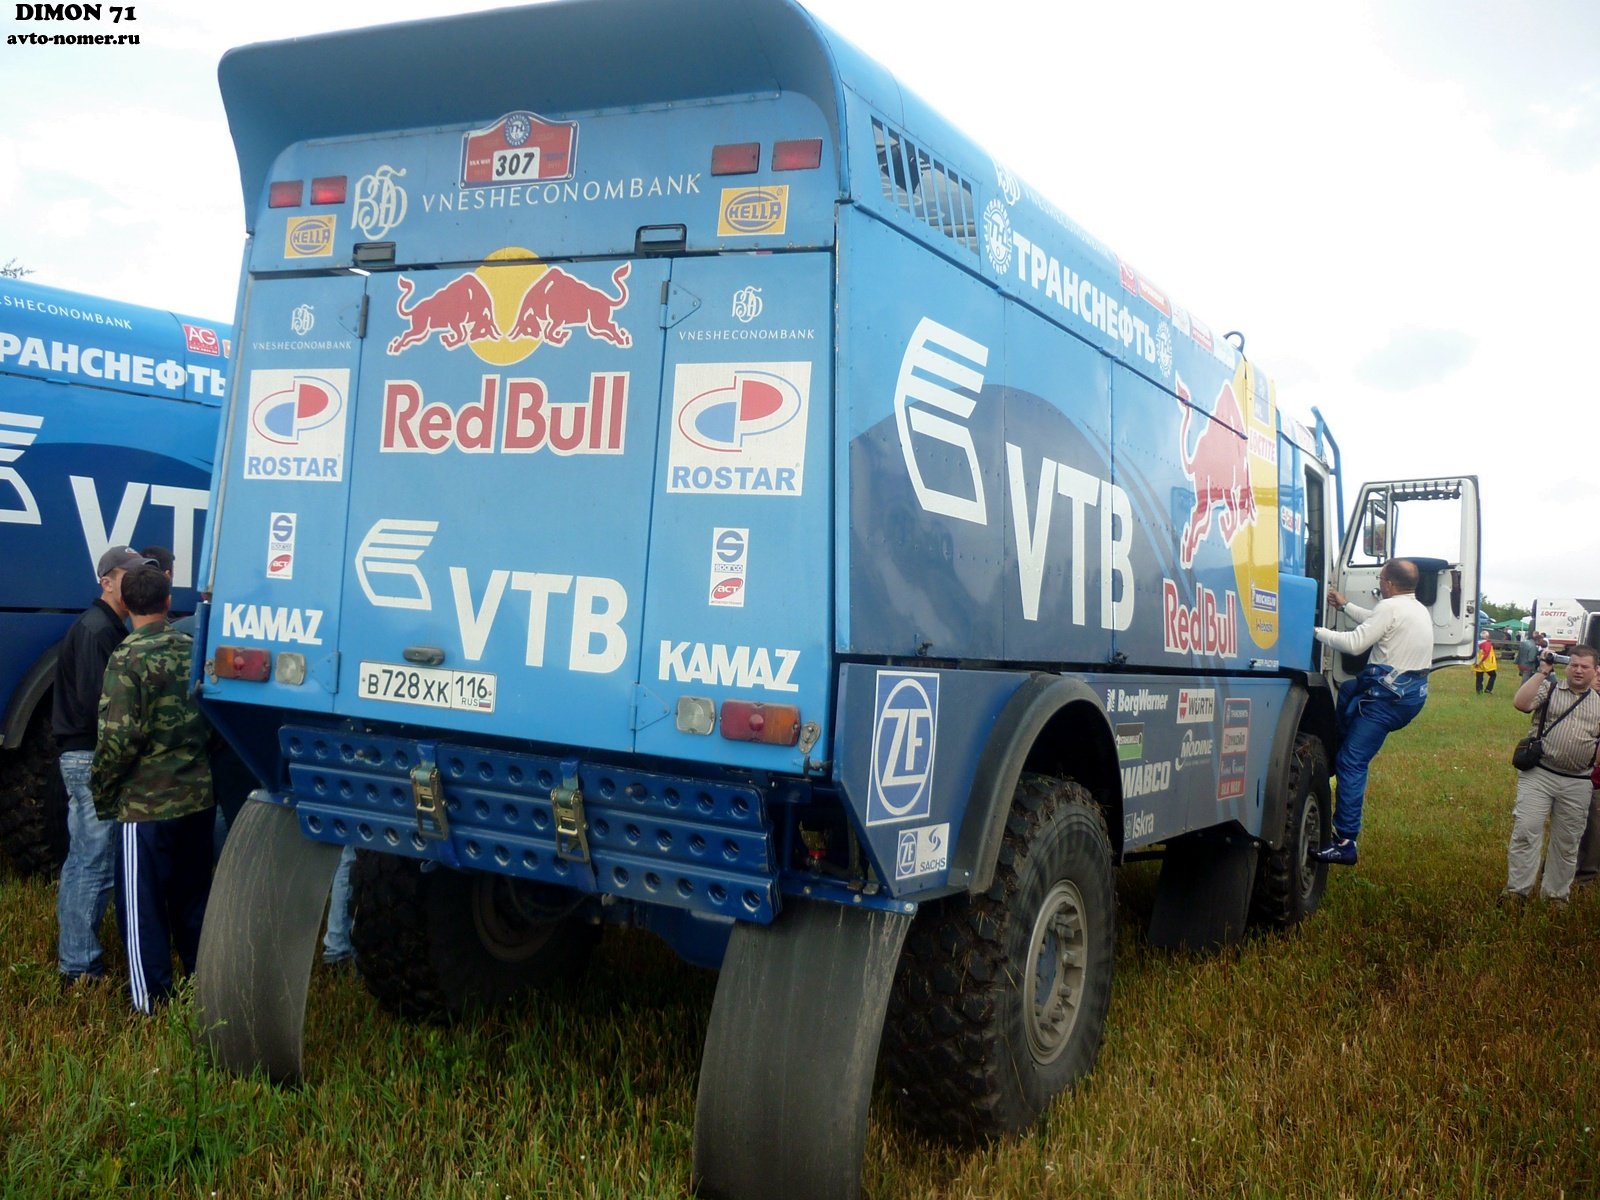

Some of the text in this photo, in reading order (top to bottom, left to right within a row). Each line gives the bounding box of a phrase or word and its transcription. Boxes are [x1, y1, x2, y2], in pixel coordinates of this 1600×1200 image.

[495, 151, 535, 177] 307
[422, 172, 702, 213] VNESHECONOMBANK
[728, 202, 782, 220] HELLA
[293, 229, 331, 244] HELLA
[1012, 230, 1156, 364] ТРАНСНЕФТЬ
[252, 341, 352, 350] VNESHECONOMBANK
[679, 328, 816, 341] VNESHECONOMBANK
[382, 371, 629, 453] Red Bull
[247, 456, 338, 478] ROSTAR
[672, 466, 796, 492] ROSTAR
[1005, 441, 1135, 631] VTB
[222, 602, 324, 646] KAMAZ
[449, 565, 629, 674] VTB
[1163, 580, 1238, 658] Red Bull
[658, 640, 802, 692] KAMAZ
[455, 675, 489, 699] 116
[461, 697, 478, 706] RUS
[1118, 689, 1168, 716] BorgWarner
[881, 709, 930, 787] ZF
[1180, 739, 1213, 758] MODINE
[1120, 760, 1172, 799] WABCO
[1132, 809, 1155, 839] Iskra
[900, 842, 916, 867] ZF
[920, 857, 947, 873] SACHS
